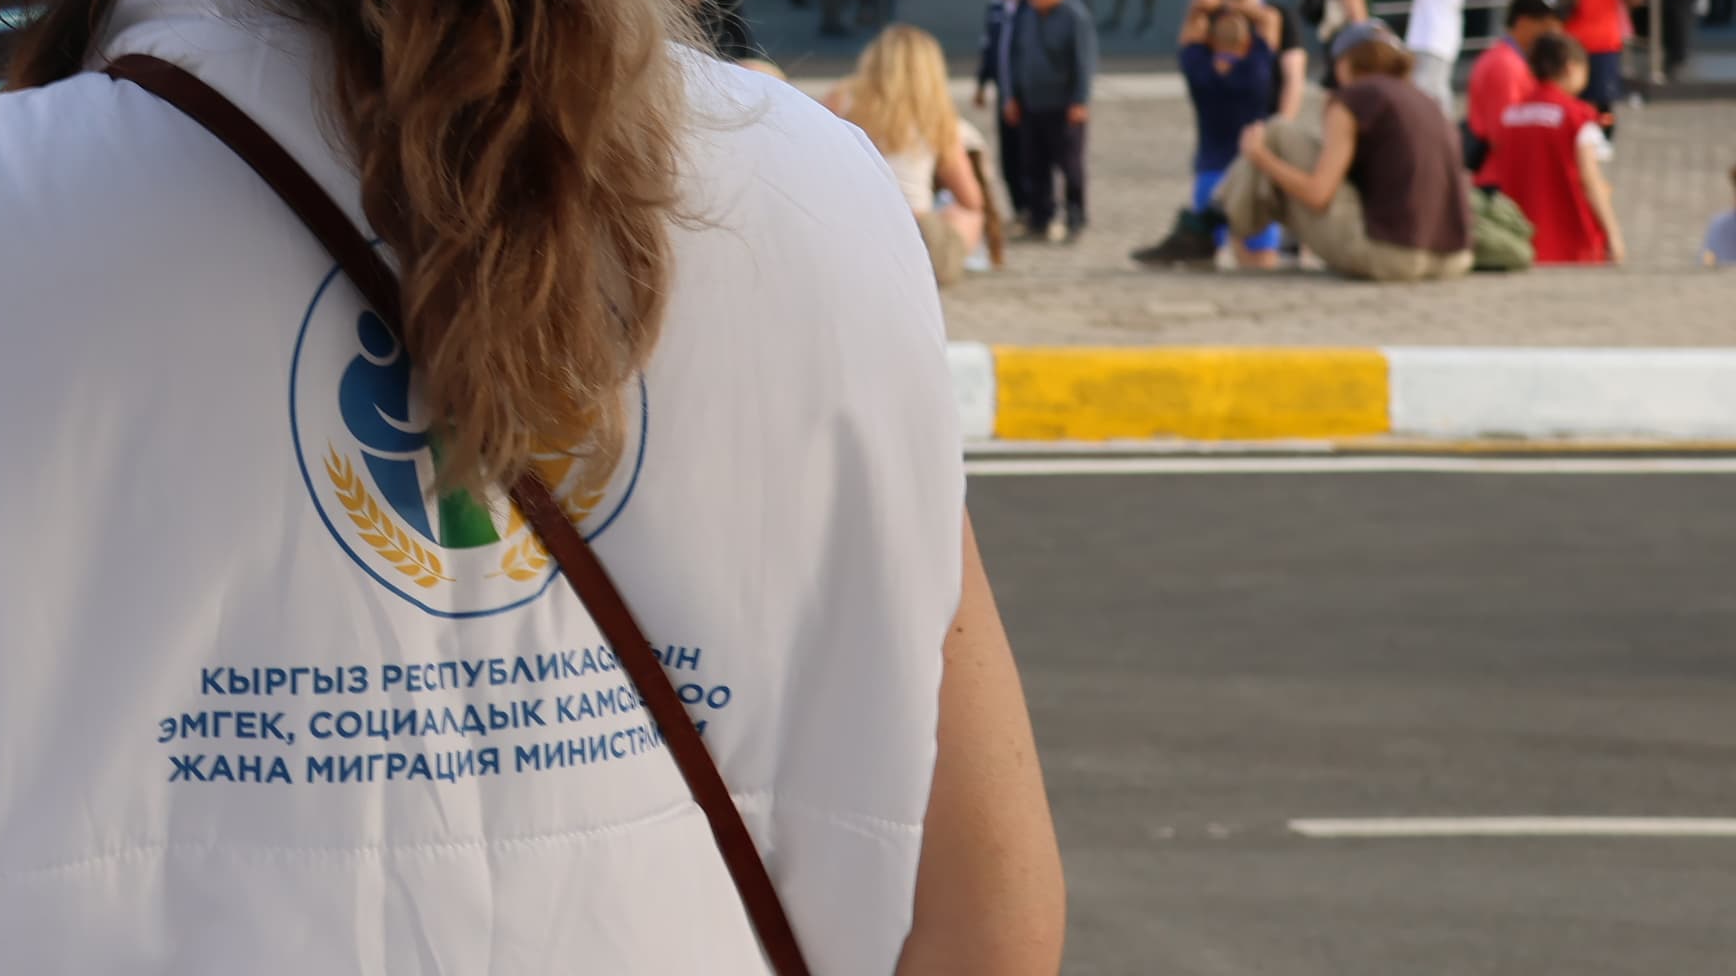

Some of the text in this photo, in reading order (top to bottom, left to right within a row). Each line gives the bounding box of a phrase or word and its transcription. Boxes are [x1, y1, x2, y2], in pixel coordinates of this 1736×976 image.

[202, 665, 369, 696] КЫРГЫЗ
[157, 711, 296, 746] ЭМГЕК,
[309, 699, 547, 742] СОЦИАЛДЫК
[168, 753, 294, 784] ЖАНА
[306, 747, 501, 784] МИГРАЦИЯ
